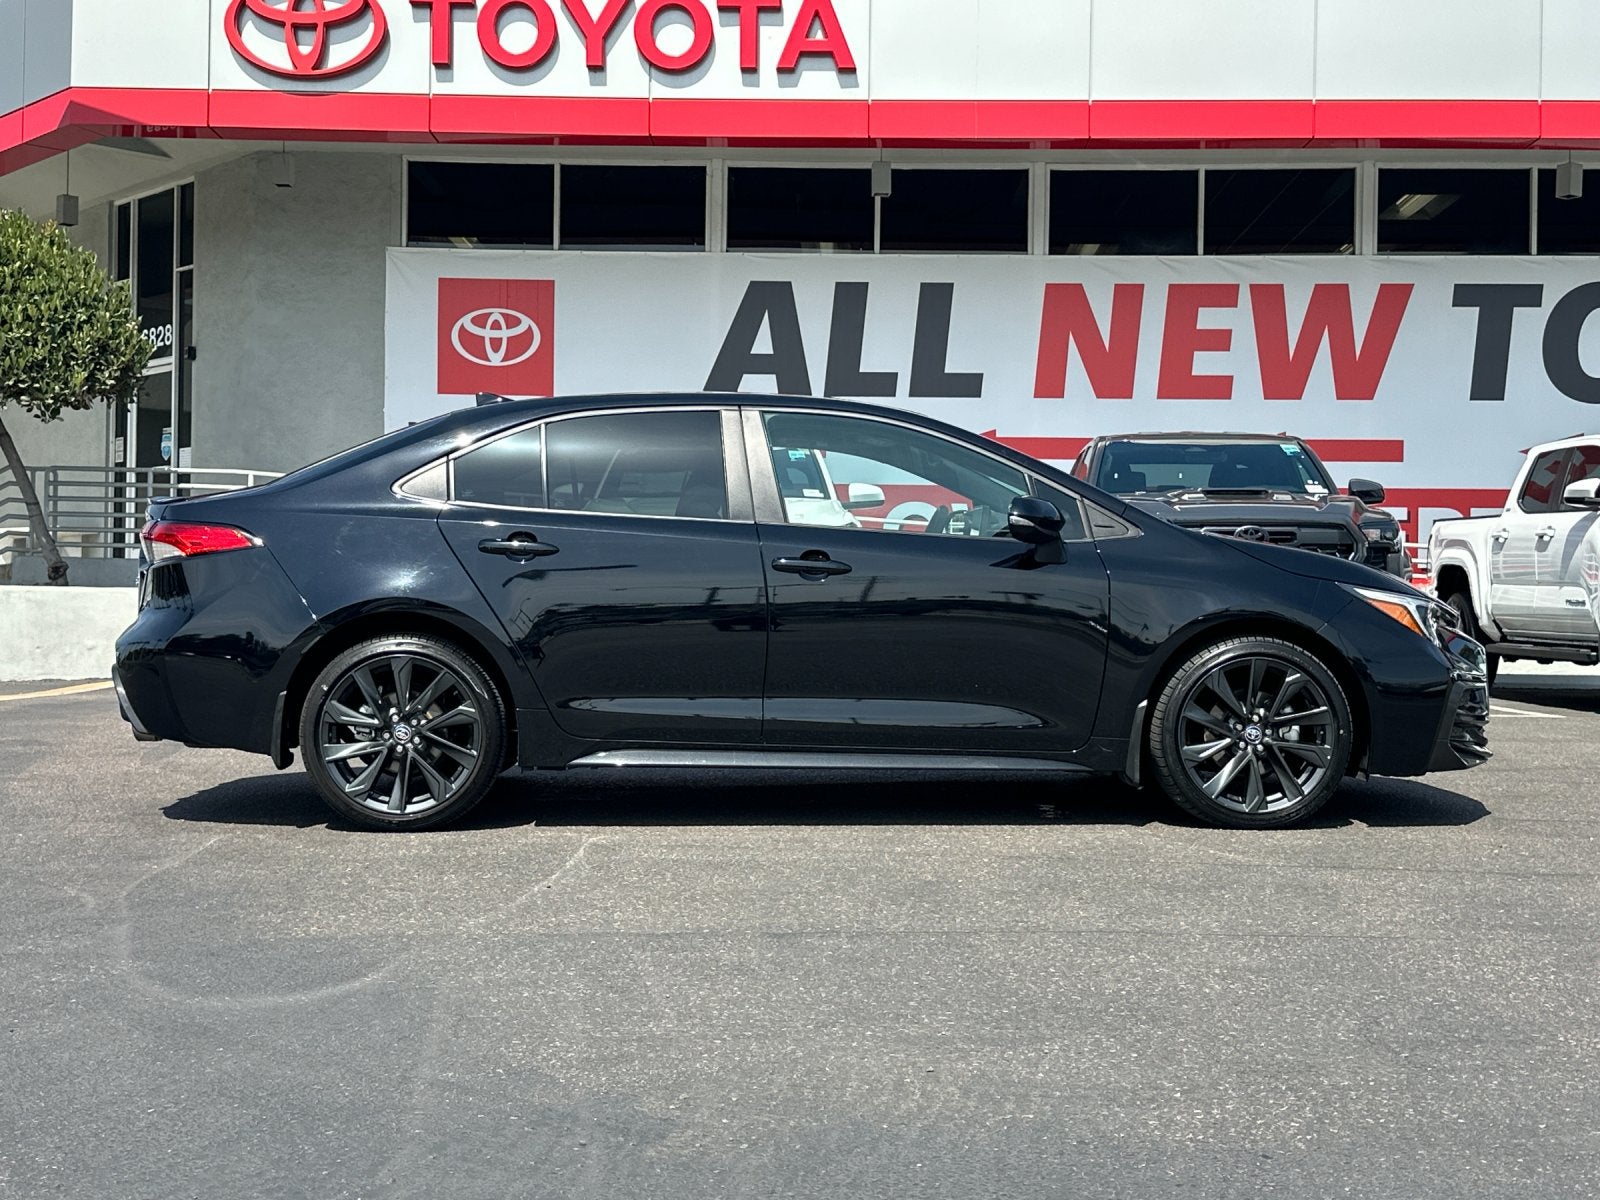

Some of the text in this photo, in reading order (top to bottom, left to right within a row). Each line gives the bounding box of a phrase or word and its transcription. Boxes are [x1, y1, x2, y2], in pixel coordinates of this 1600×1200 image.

[409, 0, 857, 72] TOYOTA
[703, 280, 984, 398] ALL
[1034, 283, 1414, 400] NEW
